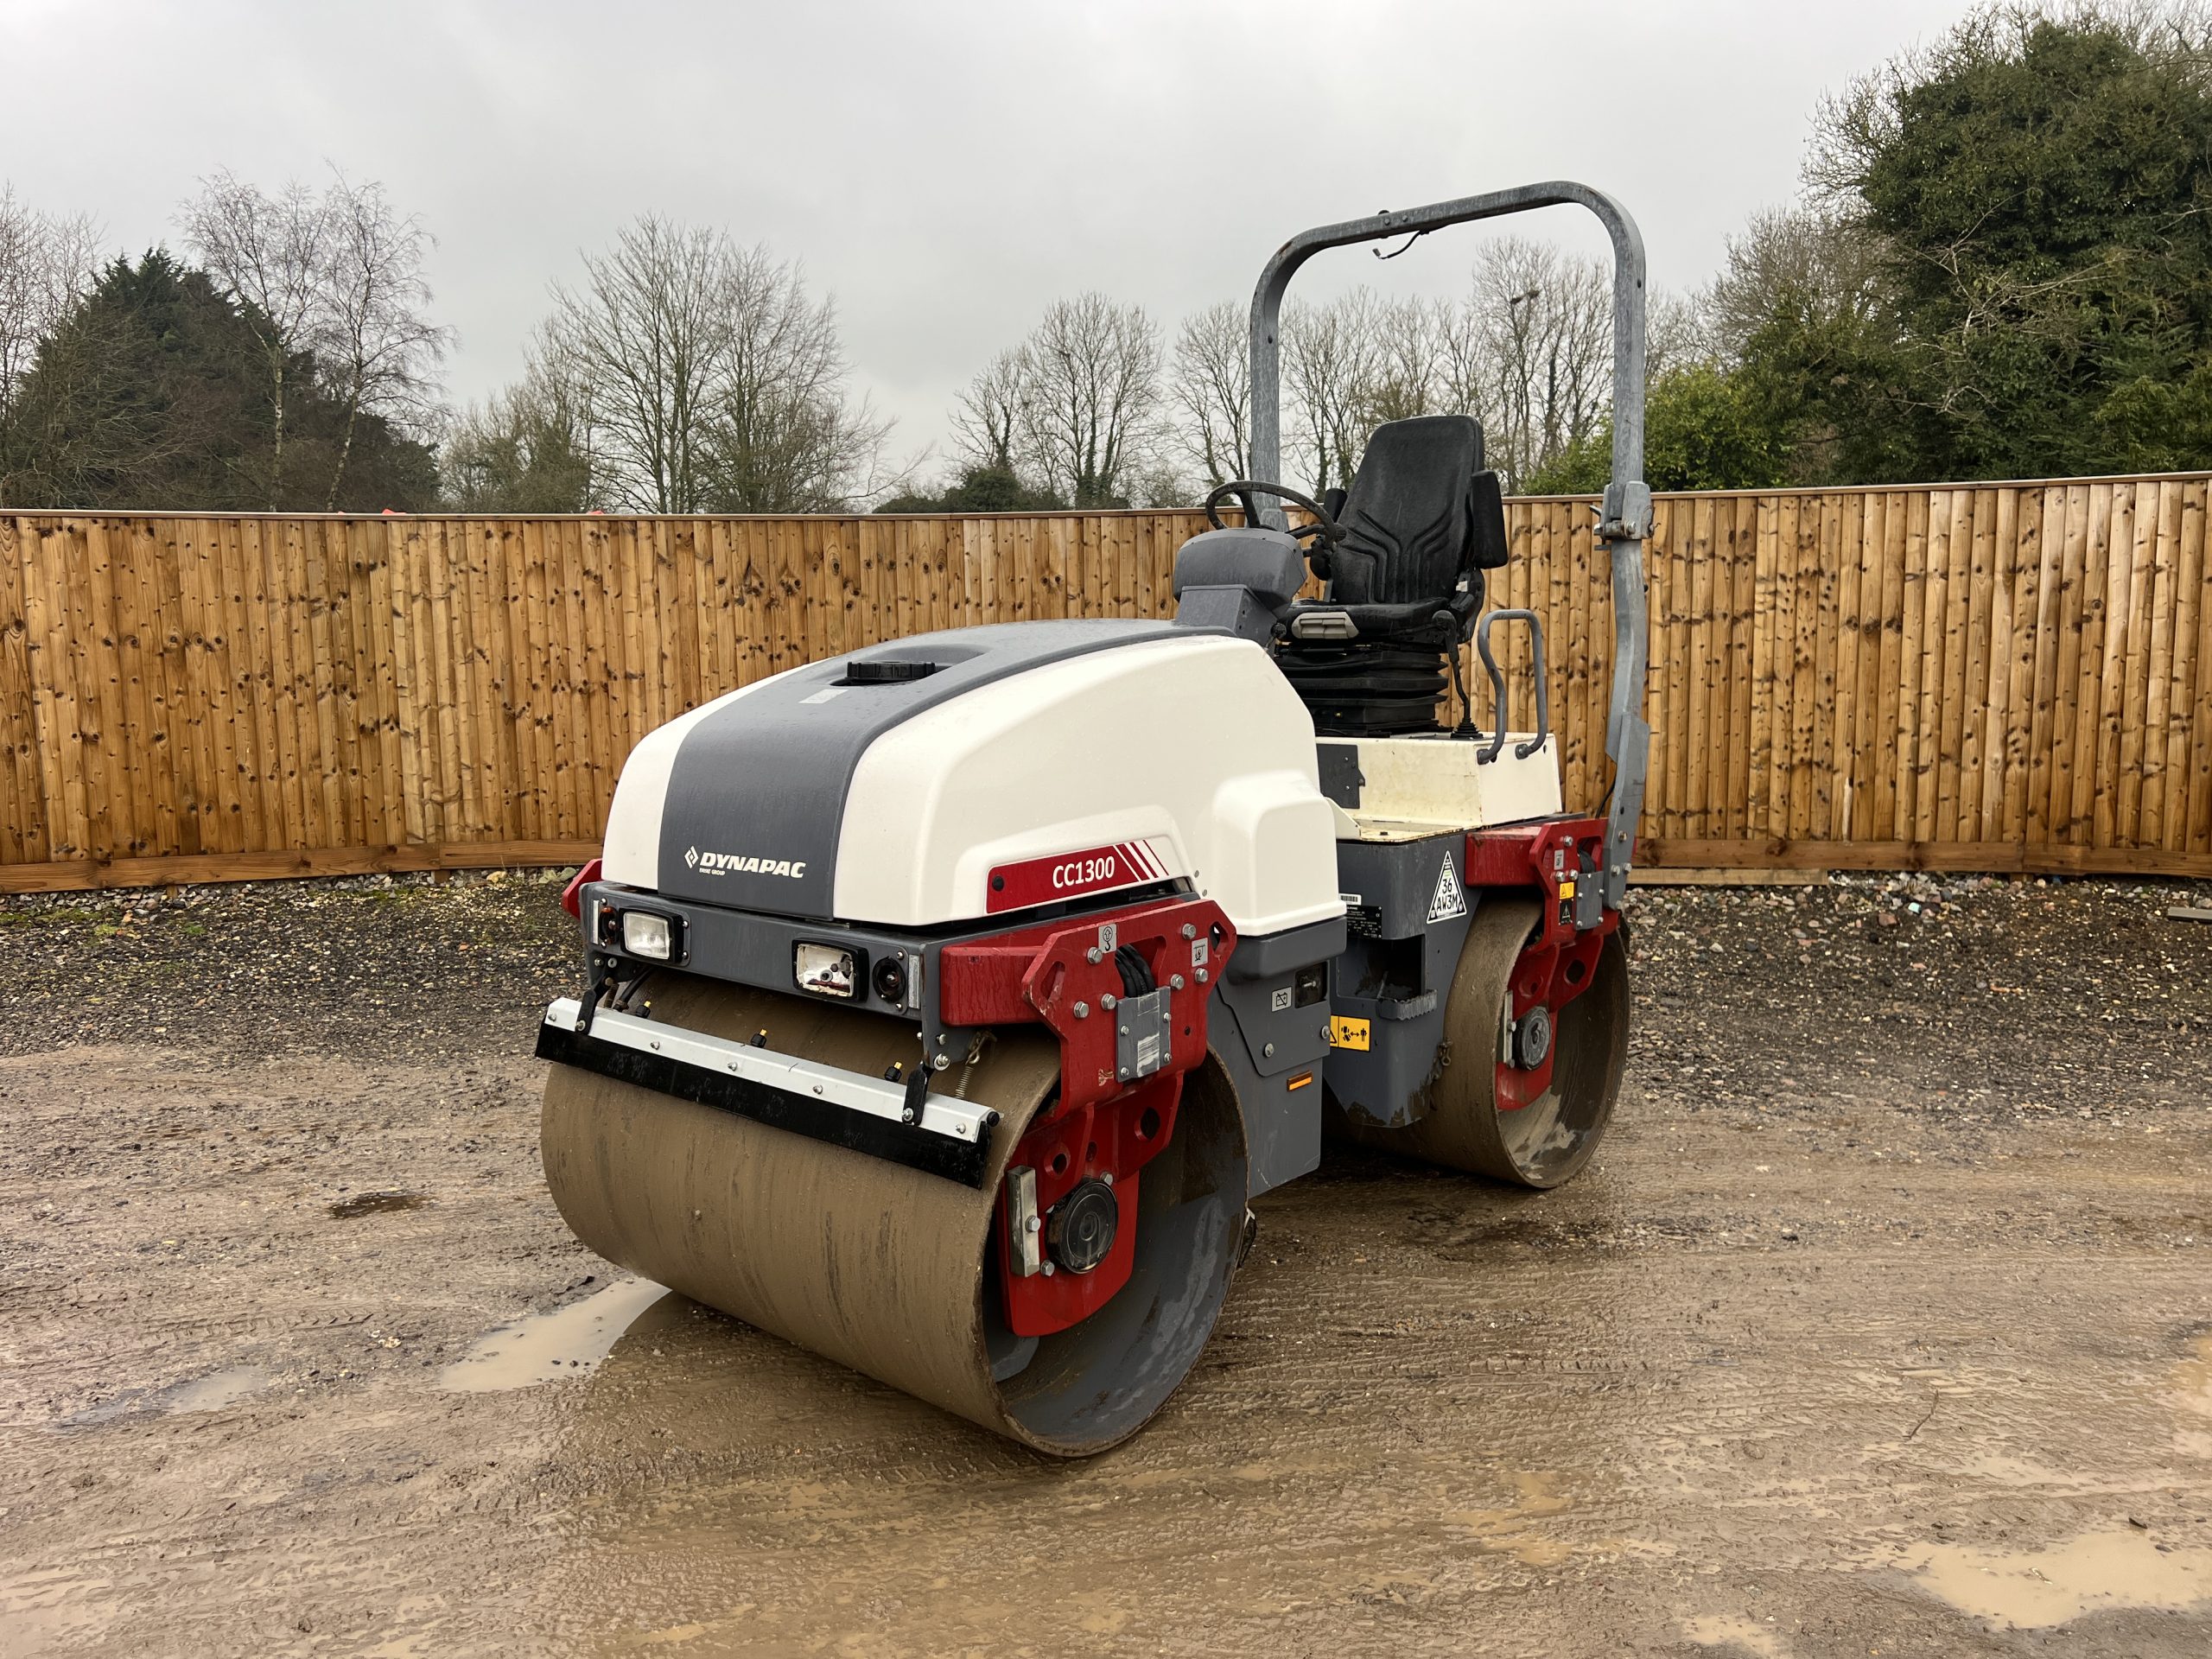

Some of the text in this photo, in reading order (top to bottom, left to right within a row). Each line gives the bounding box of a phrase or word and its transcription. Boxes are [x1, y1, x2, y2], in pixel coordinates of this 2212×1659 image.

[700, 852, 806, 878] DYNAPAC
[1052, 856, 1115, 888] CC1300
[1442, 878, 1452, 894] 36
[1436, 893, 1459, 912] AW3M
